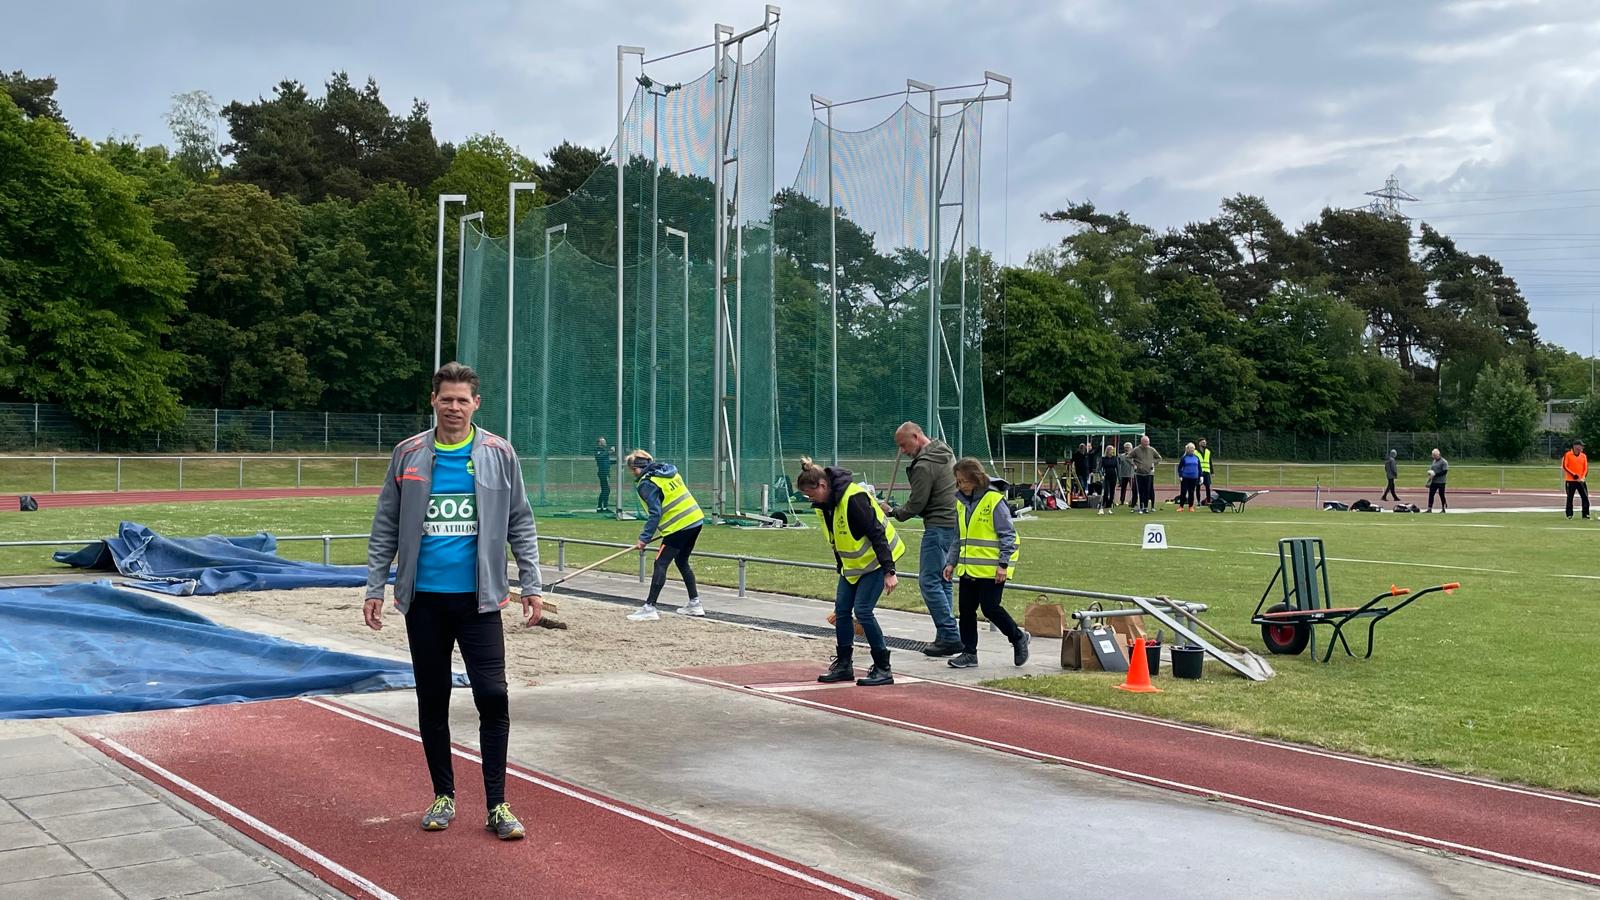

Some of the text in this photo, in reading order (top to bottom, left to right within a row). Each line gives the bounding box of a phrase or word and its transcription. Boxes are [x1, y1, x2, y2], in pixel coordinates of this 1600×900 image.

[426, 498, 474, 519] 606
[444, 523, 476, 534] ATHLOS
[1147, 531, 1163, 544] 20
